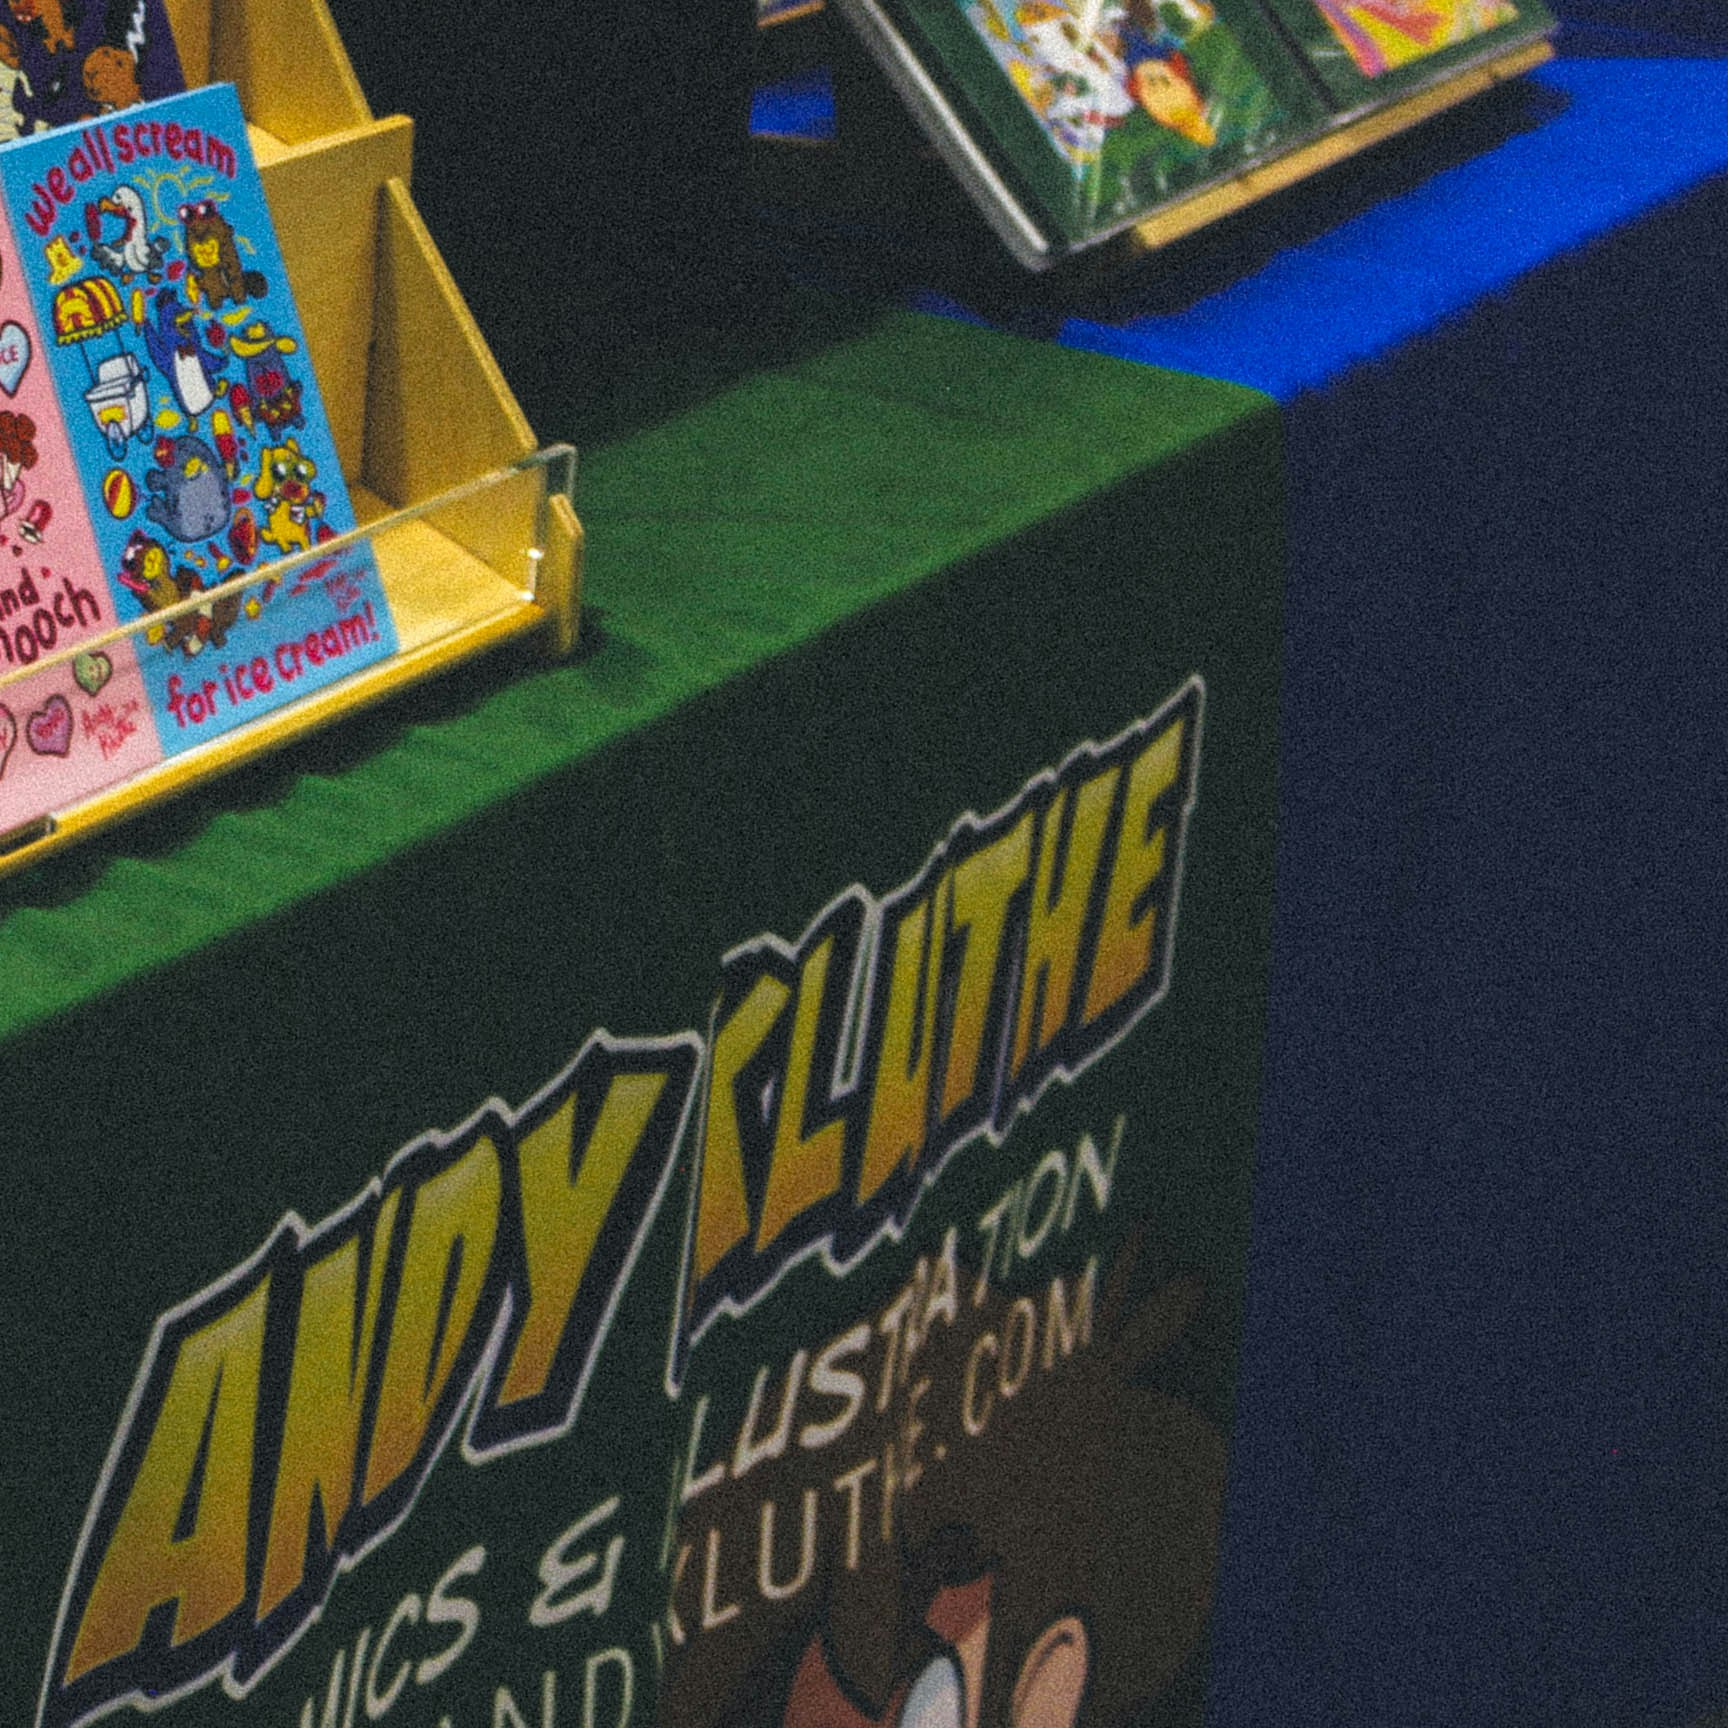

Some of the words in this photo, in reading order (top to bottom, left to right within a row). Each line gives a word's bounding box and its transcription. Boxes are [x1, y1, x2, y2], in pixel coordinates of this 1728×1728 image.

[70, 124, 113, 183] all
[112, 113, 238, 180] scream
[165, 675, 219, 730] for
[224, 652, 273, 700] ice
[274, 604, 382, 681] cream!
[58, 1067, 674, 1688] ANDY
[691, 714, 1187, 1280] KLUTHE
[528, 1494, 625, 1627] &
